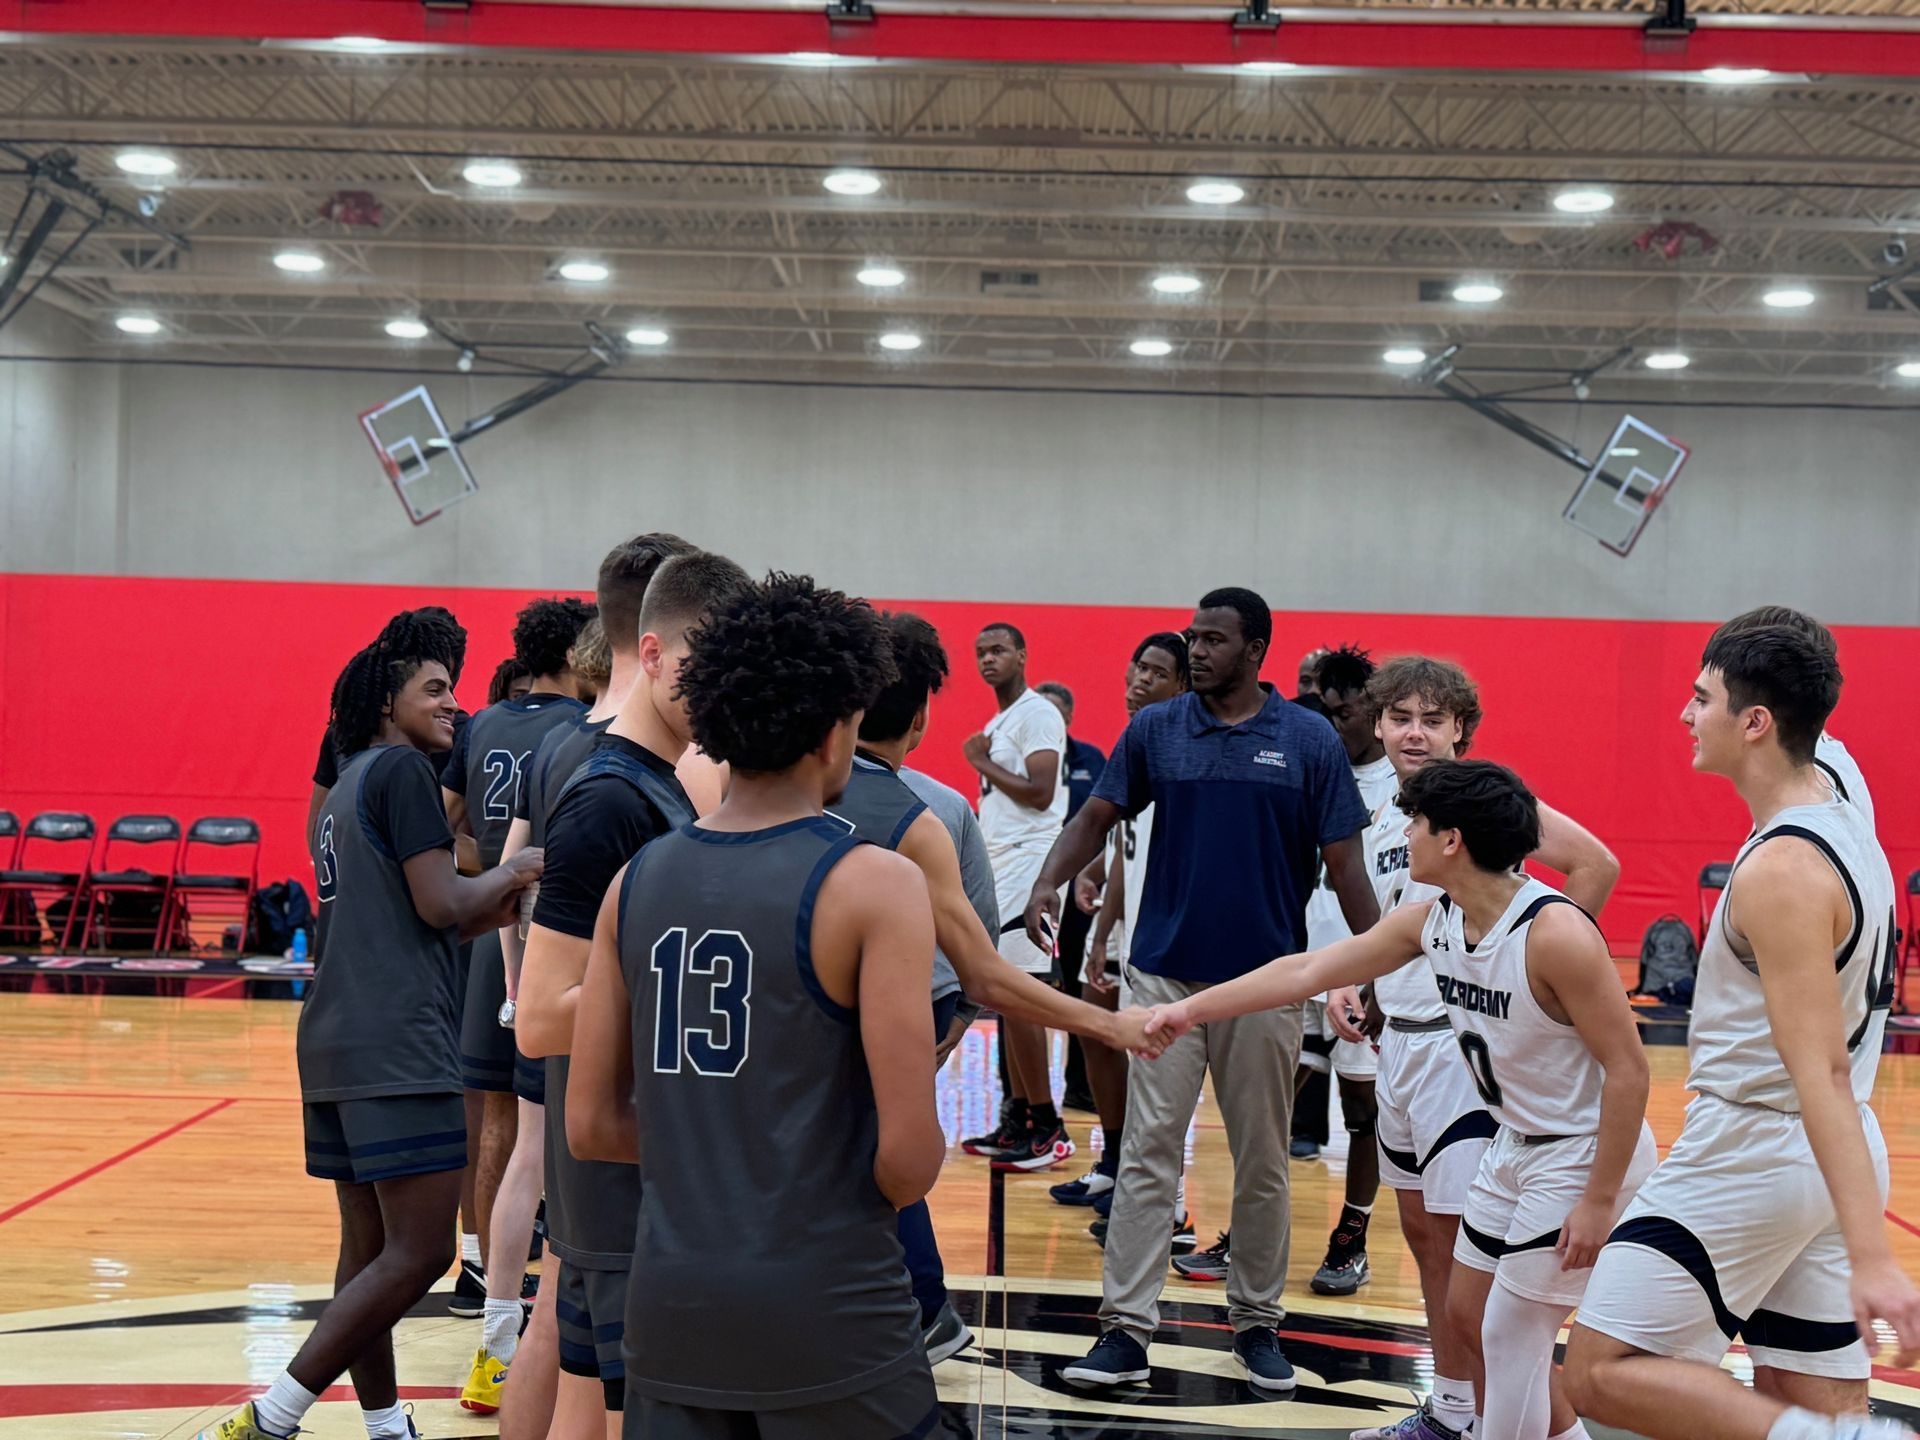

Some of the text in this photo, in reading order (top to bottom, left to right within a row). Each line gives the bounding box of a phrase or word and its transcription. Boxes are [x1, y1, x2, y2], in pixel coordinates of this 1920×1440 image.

[318, 814, 338, 902] 3
[1376, 844, 1410, 877] ACADE
[650, 927, 753, 1077] 13
[1435, 974, 1513, 1020] ACADEMY
[1459, 1030, 1504, 1109] 0
